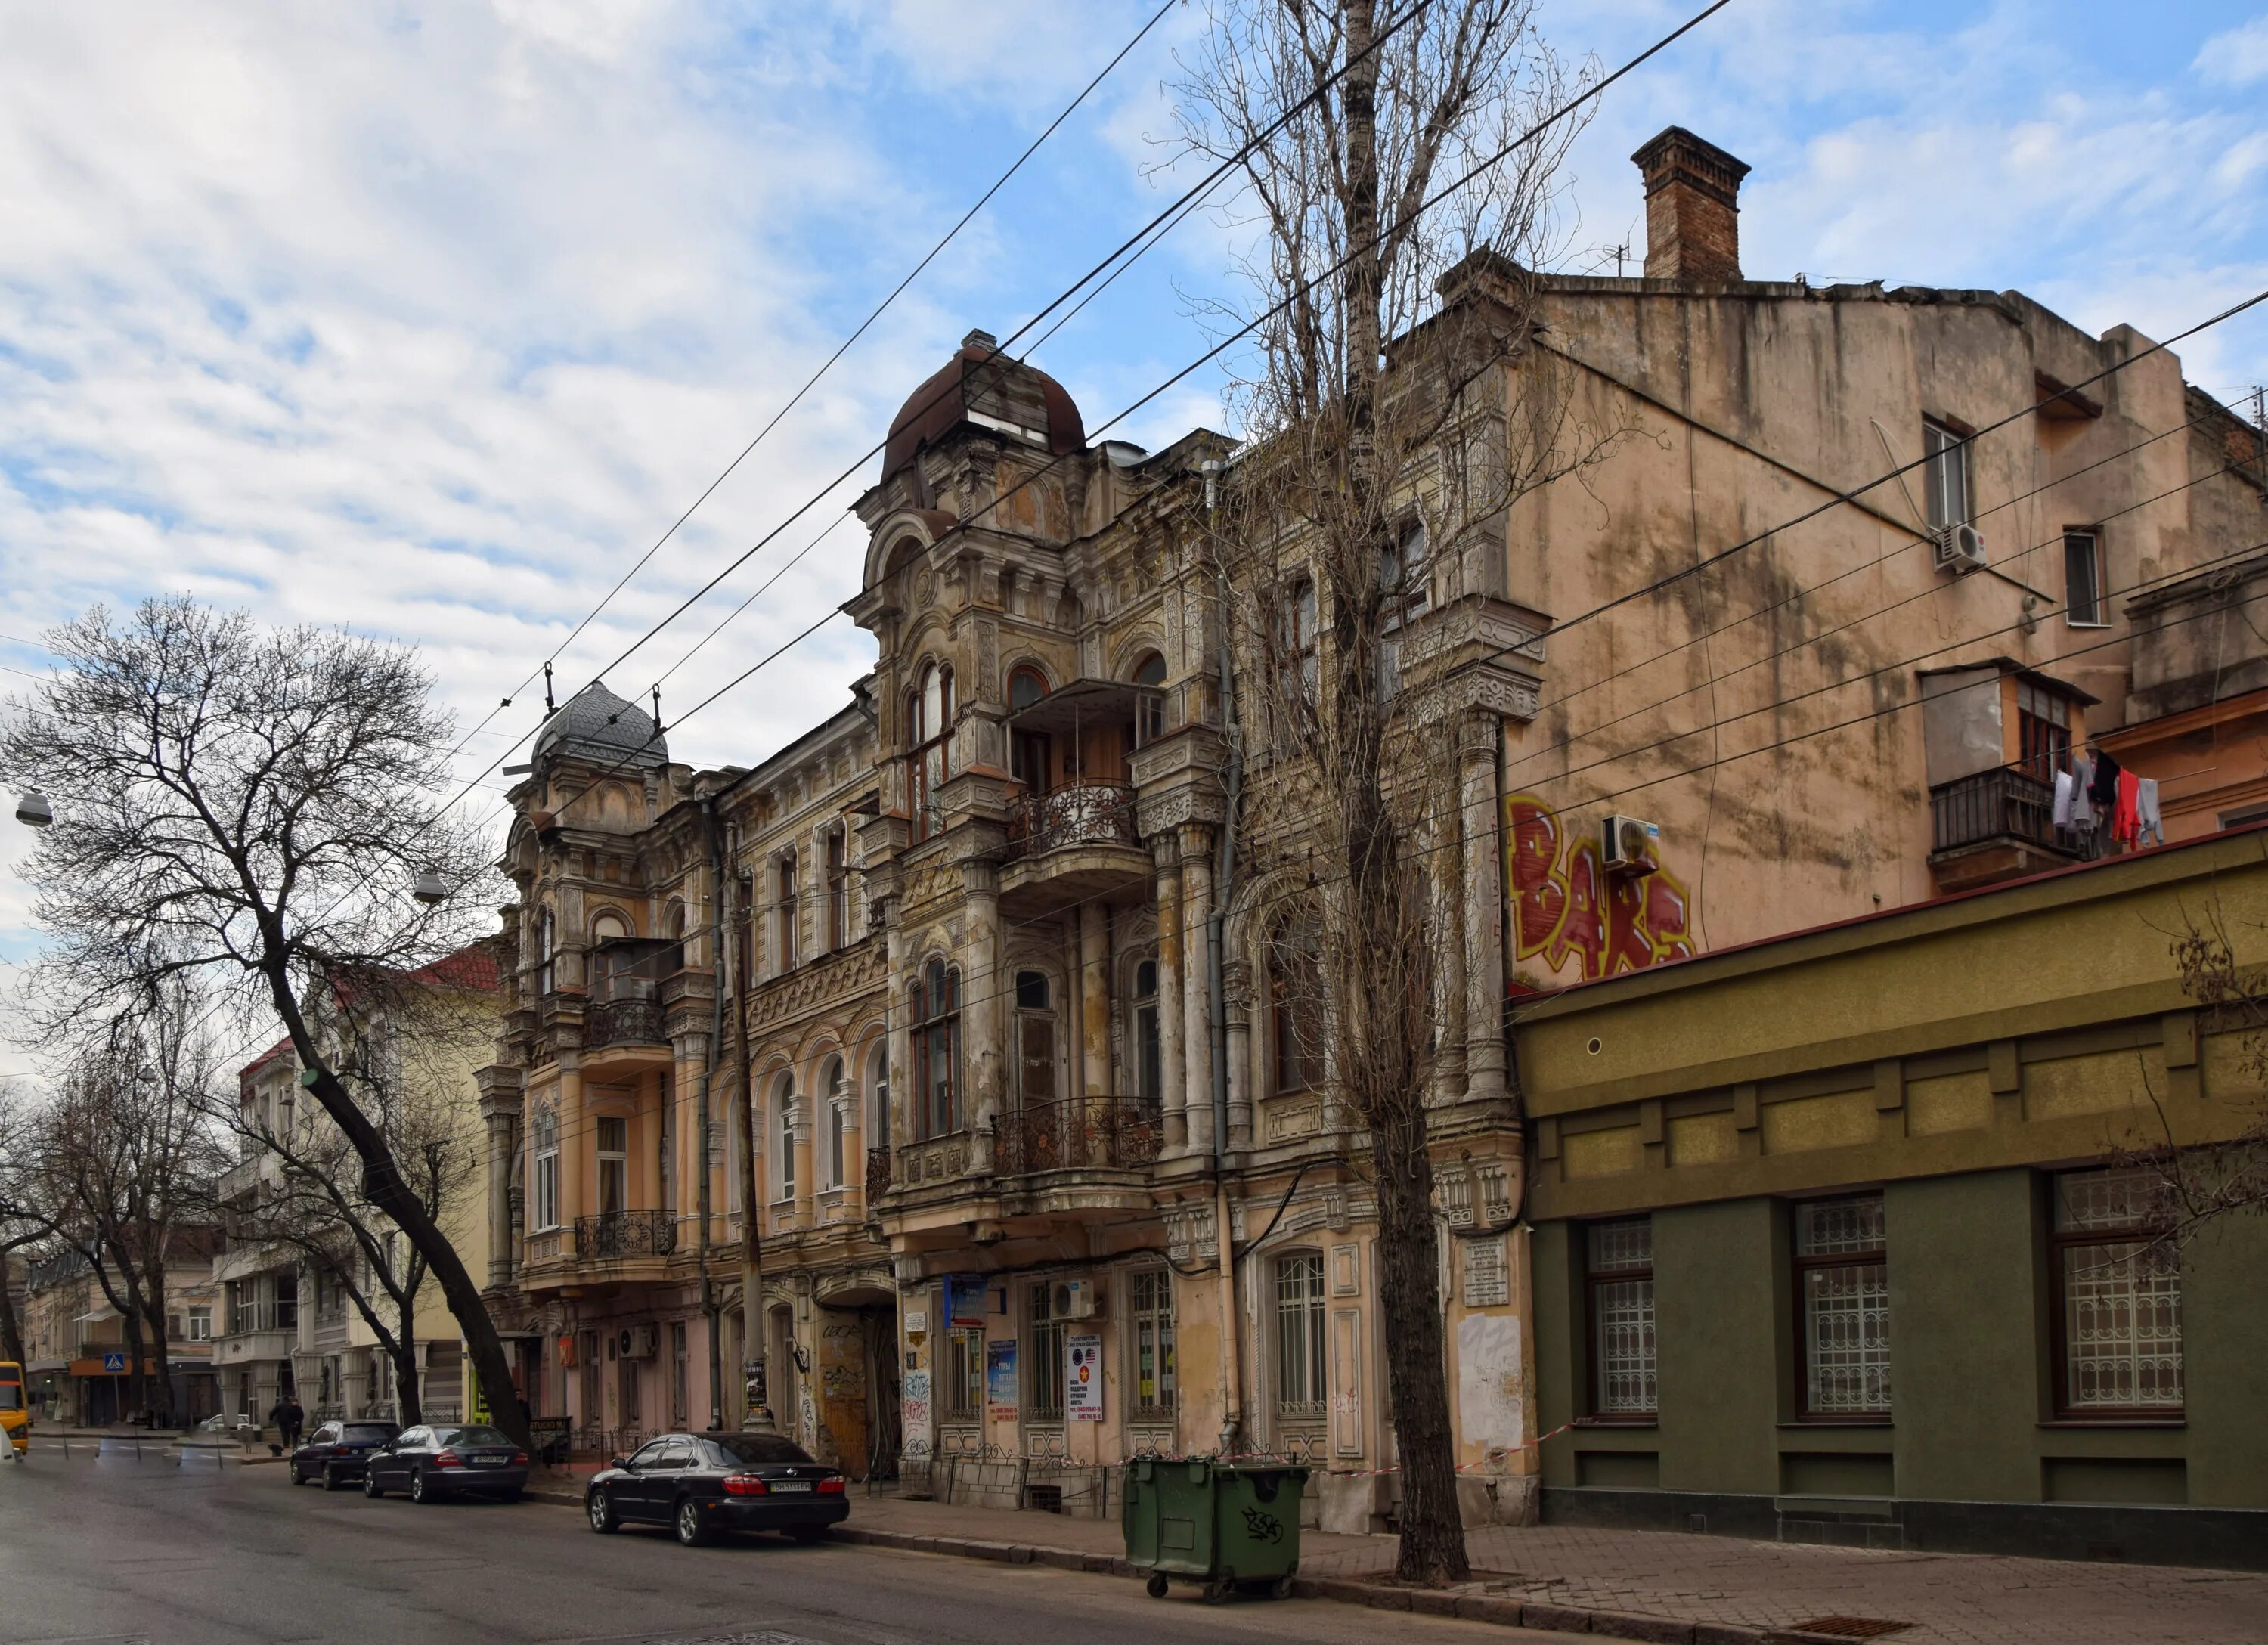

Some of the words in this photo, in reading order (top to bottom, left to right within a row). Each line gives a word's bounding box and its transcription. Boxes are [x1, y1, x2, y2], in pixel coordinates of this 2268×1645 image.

[907, 1355, 914, 1366] 28
[775, 1482, 784, 1491] BH
[785, 1482, 799, 1491] 5333
